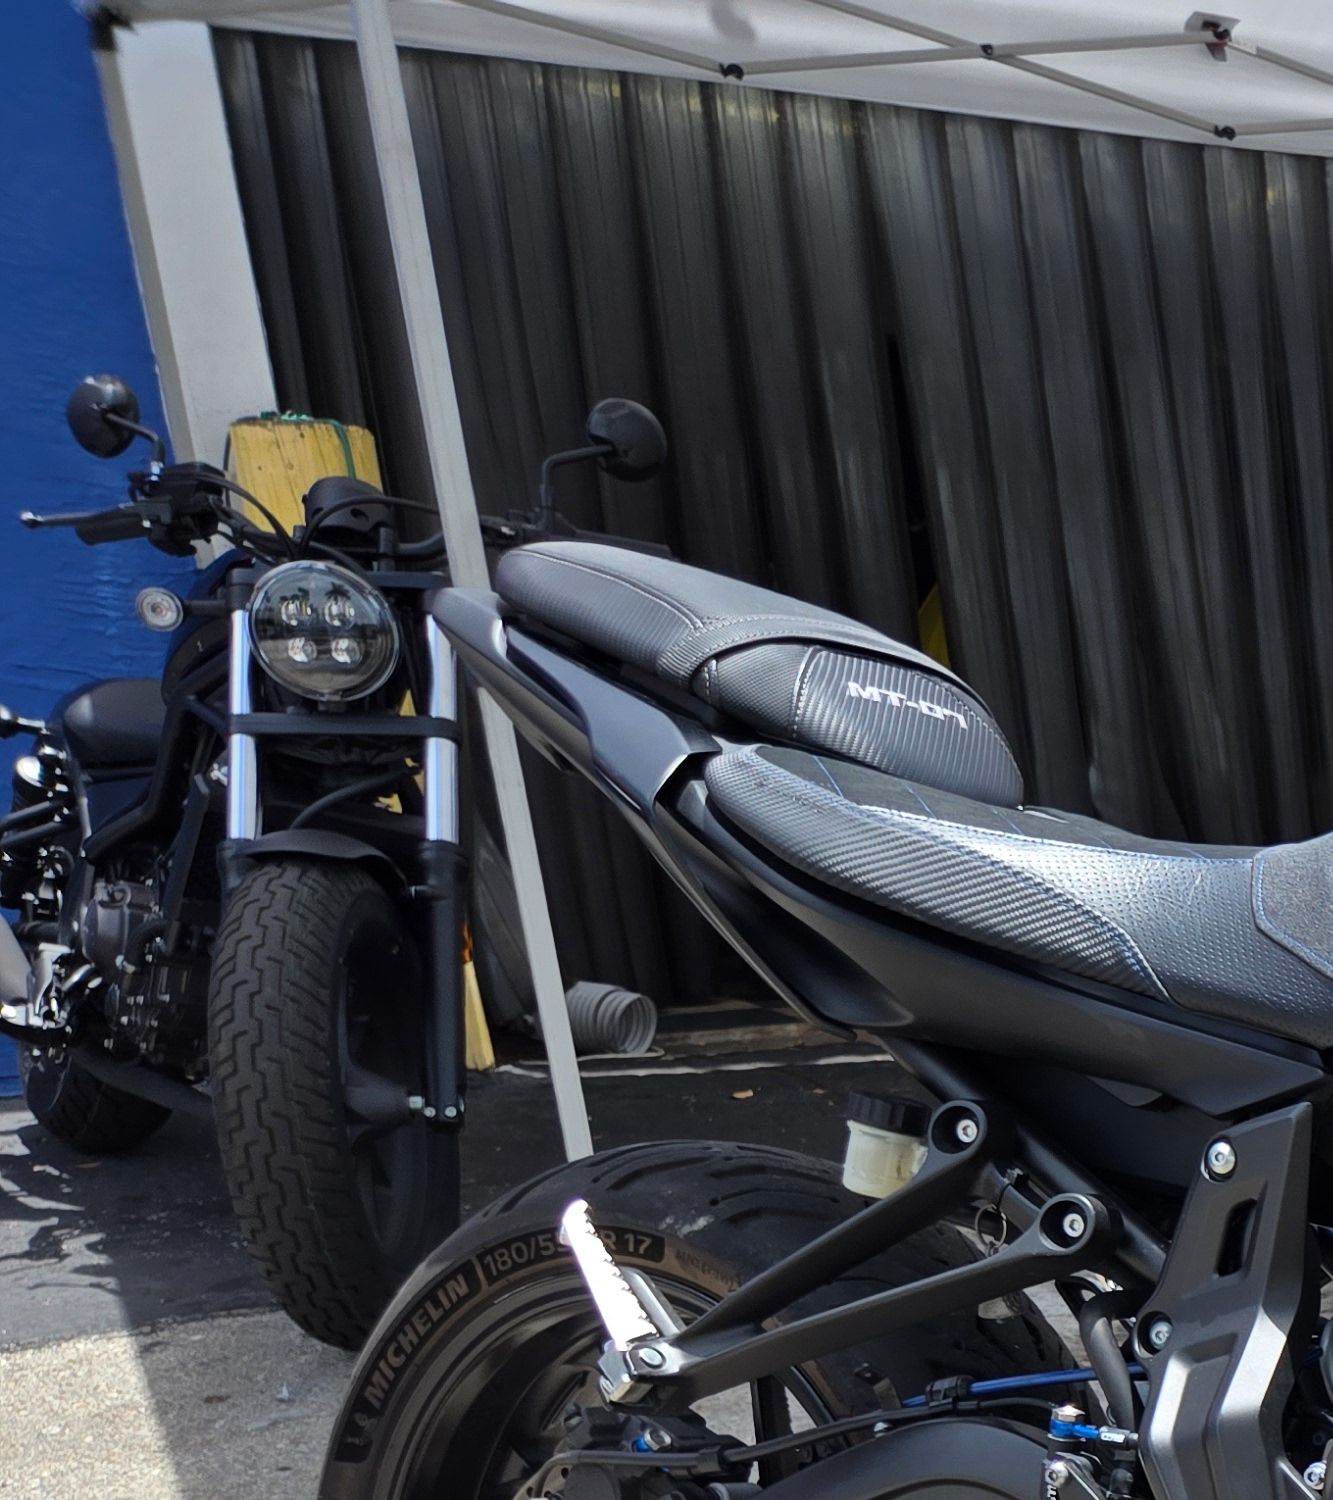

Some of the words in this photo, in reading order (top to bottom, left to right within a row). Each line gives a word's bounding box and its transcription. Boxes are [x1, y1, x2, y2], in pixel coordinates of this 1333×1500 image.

[848, 681, 968, 730] MT-07
[365, 1274, 470, 1409] MICHELIN
[622, 1235, 652, 1255] 17
